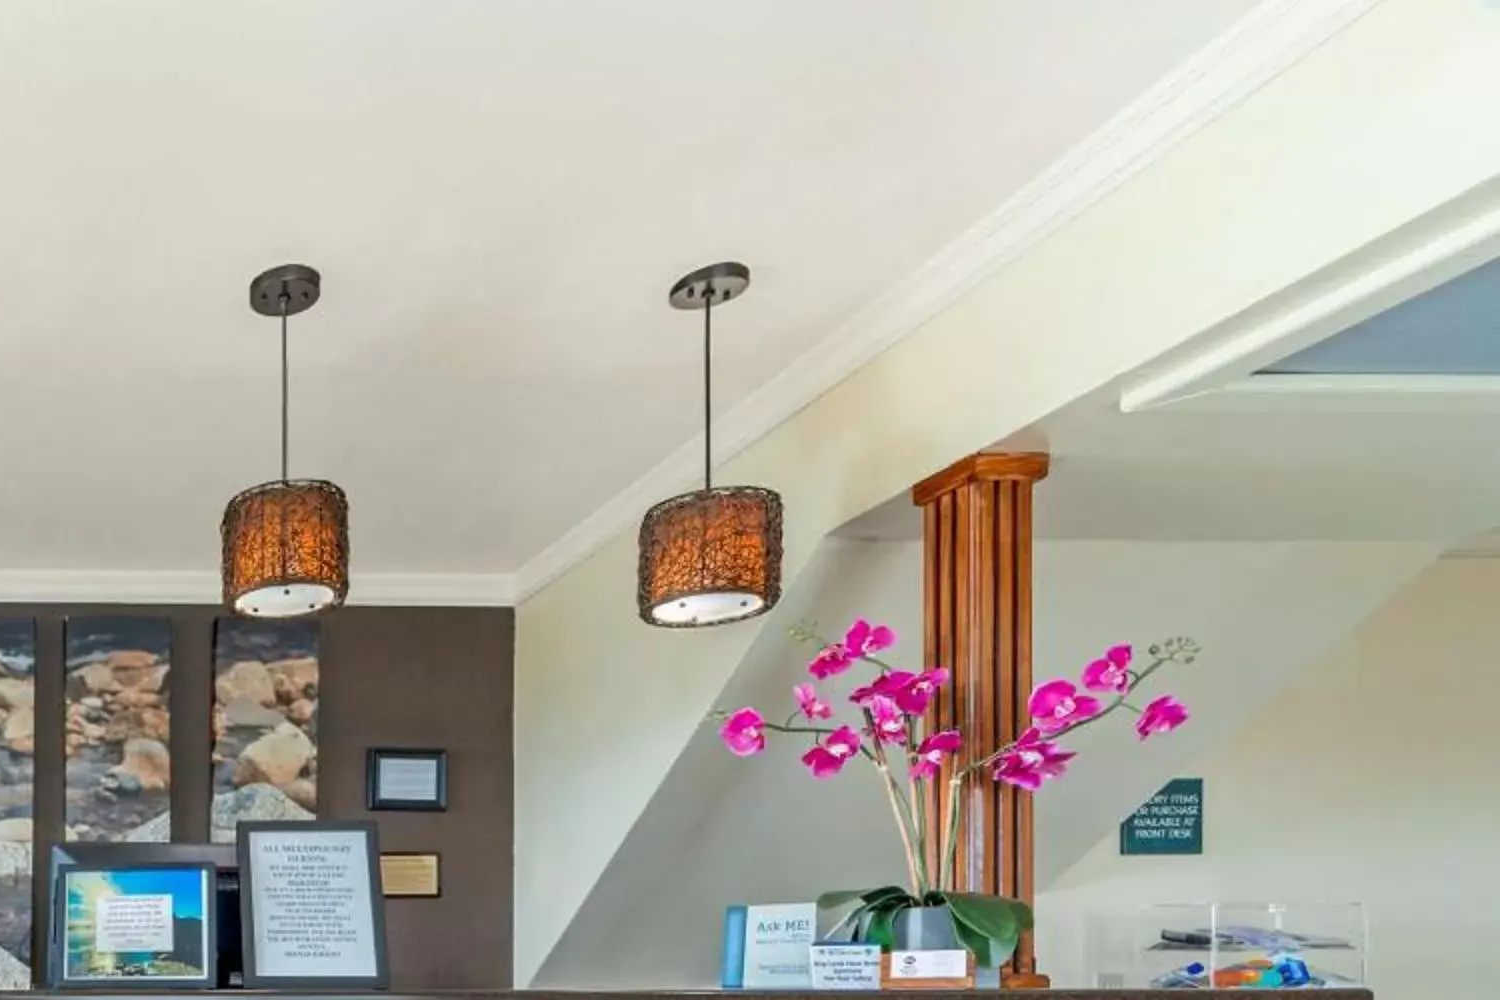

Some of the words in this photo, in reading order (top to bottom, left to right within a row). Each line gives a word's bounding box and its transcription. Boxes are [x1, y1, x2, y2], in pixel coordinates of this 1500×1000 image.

[1170, 794, 1199, 804] ITEMS
[1151, 805, 1198, 816] PURCHASE
[1133, 817, 1180, 827] AVAILABLE
[1184, 817, 1195, 827] AT
[1135, 829, 1165, 839] FRONT
[1169, 829, 1192, 839] DESK
[756, 920, 780, 932] Ask
[785, 919, 810, 931] ME!
